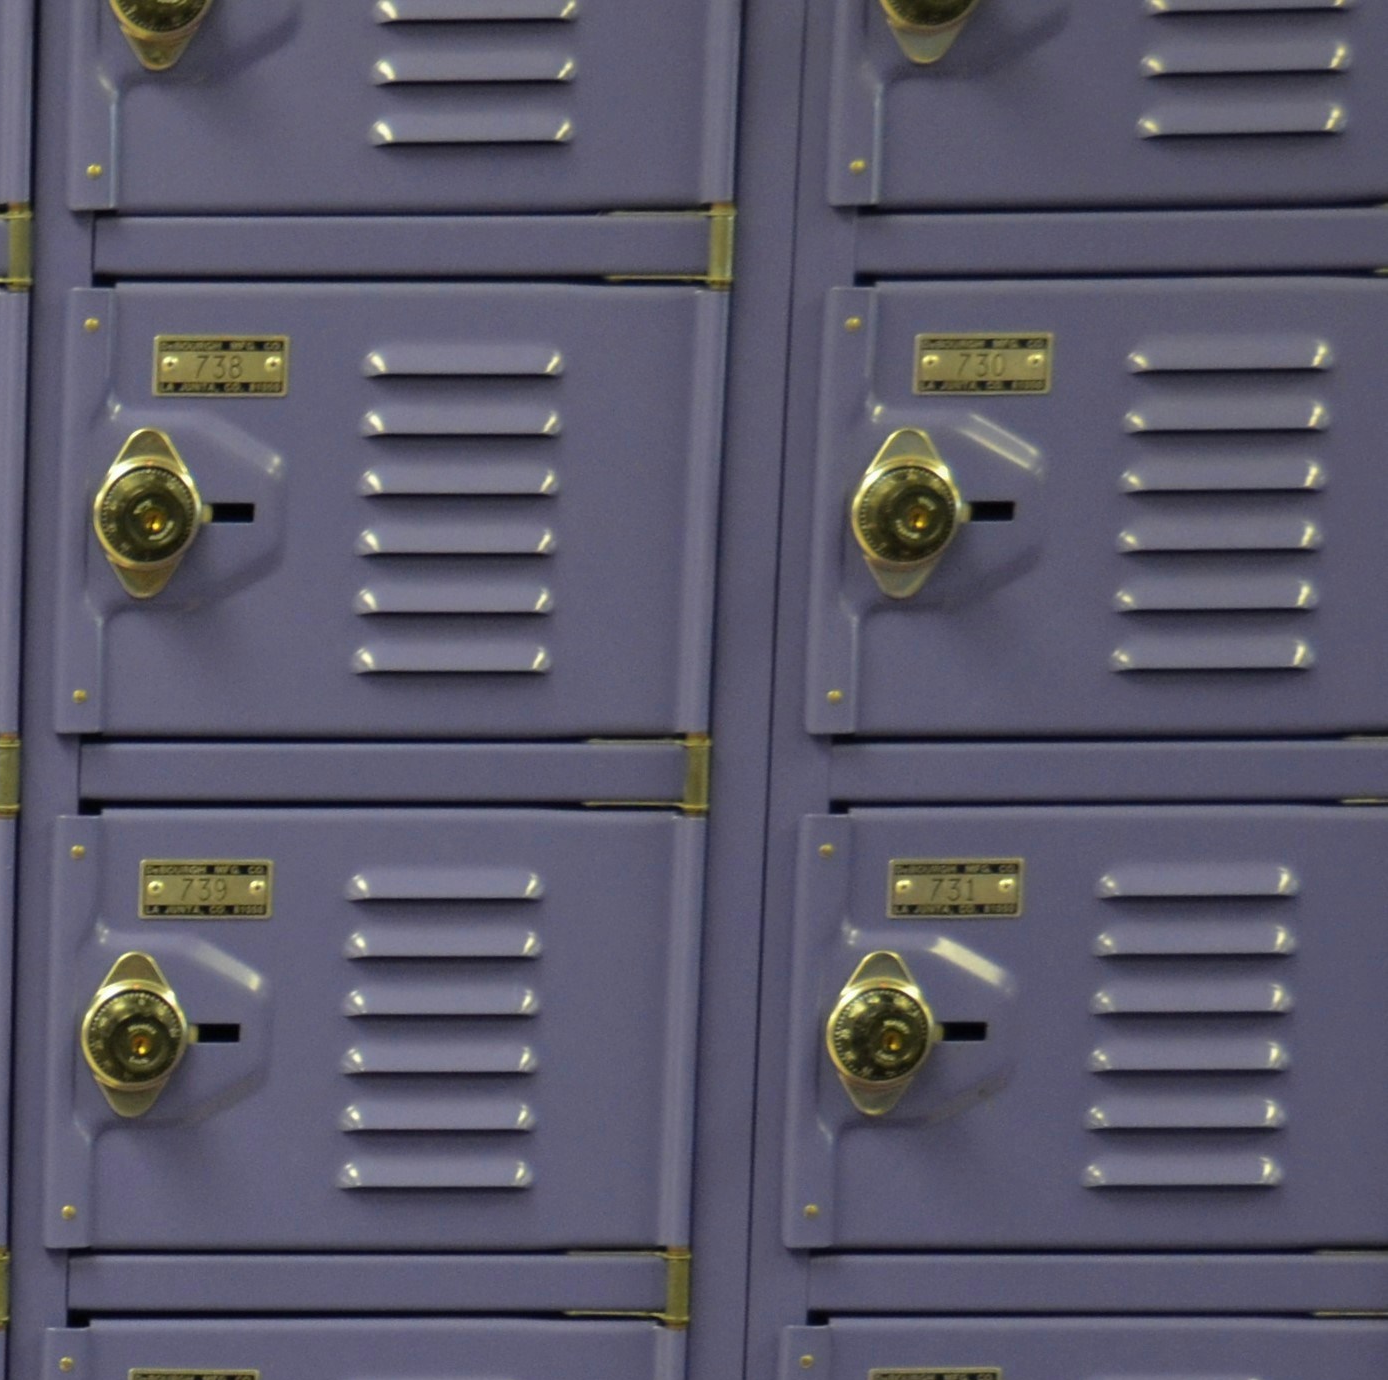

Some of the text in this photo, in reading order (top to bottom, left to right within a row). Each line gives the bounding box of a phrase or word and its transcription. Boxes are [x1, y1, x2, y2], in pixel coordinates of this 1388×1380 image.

[195, 354, 243, 379] 738
[956, 352, 1006, 378] 730
[180, 878, 228, 902] 739
[929, 877, 978, 902] 731
